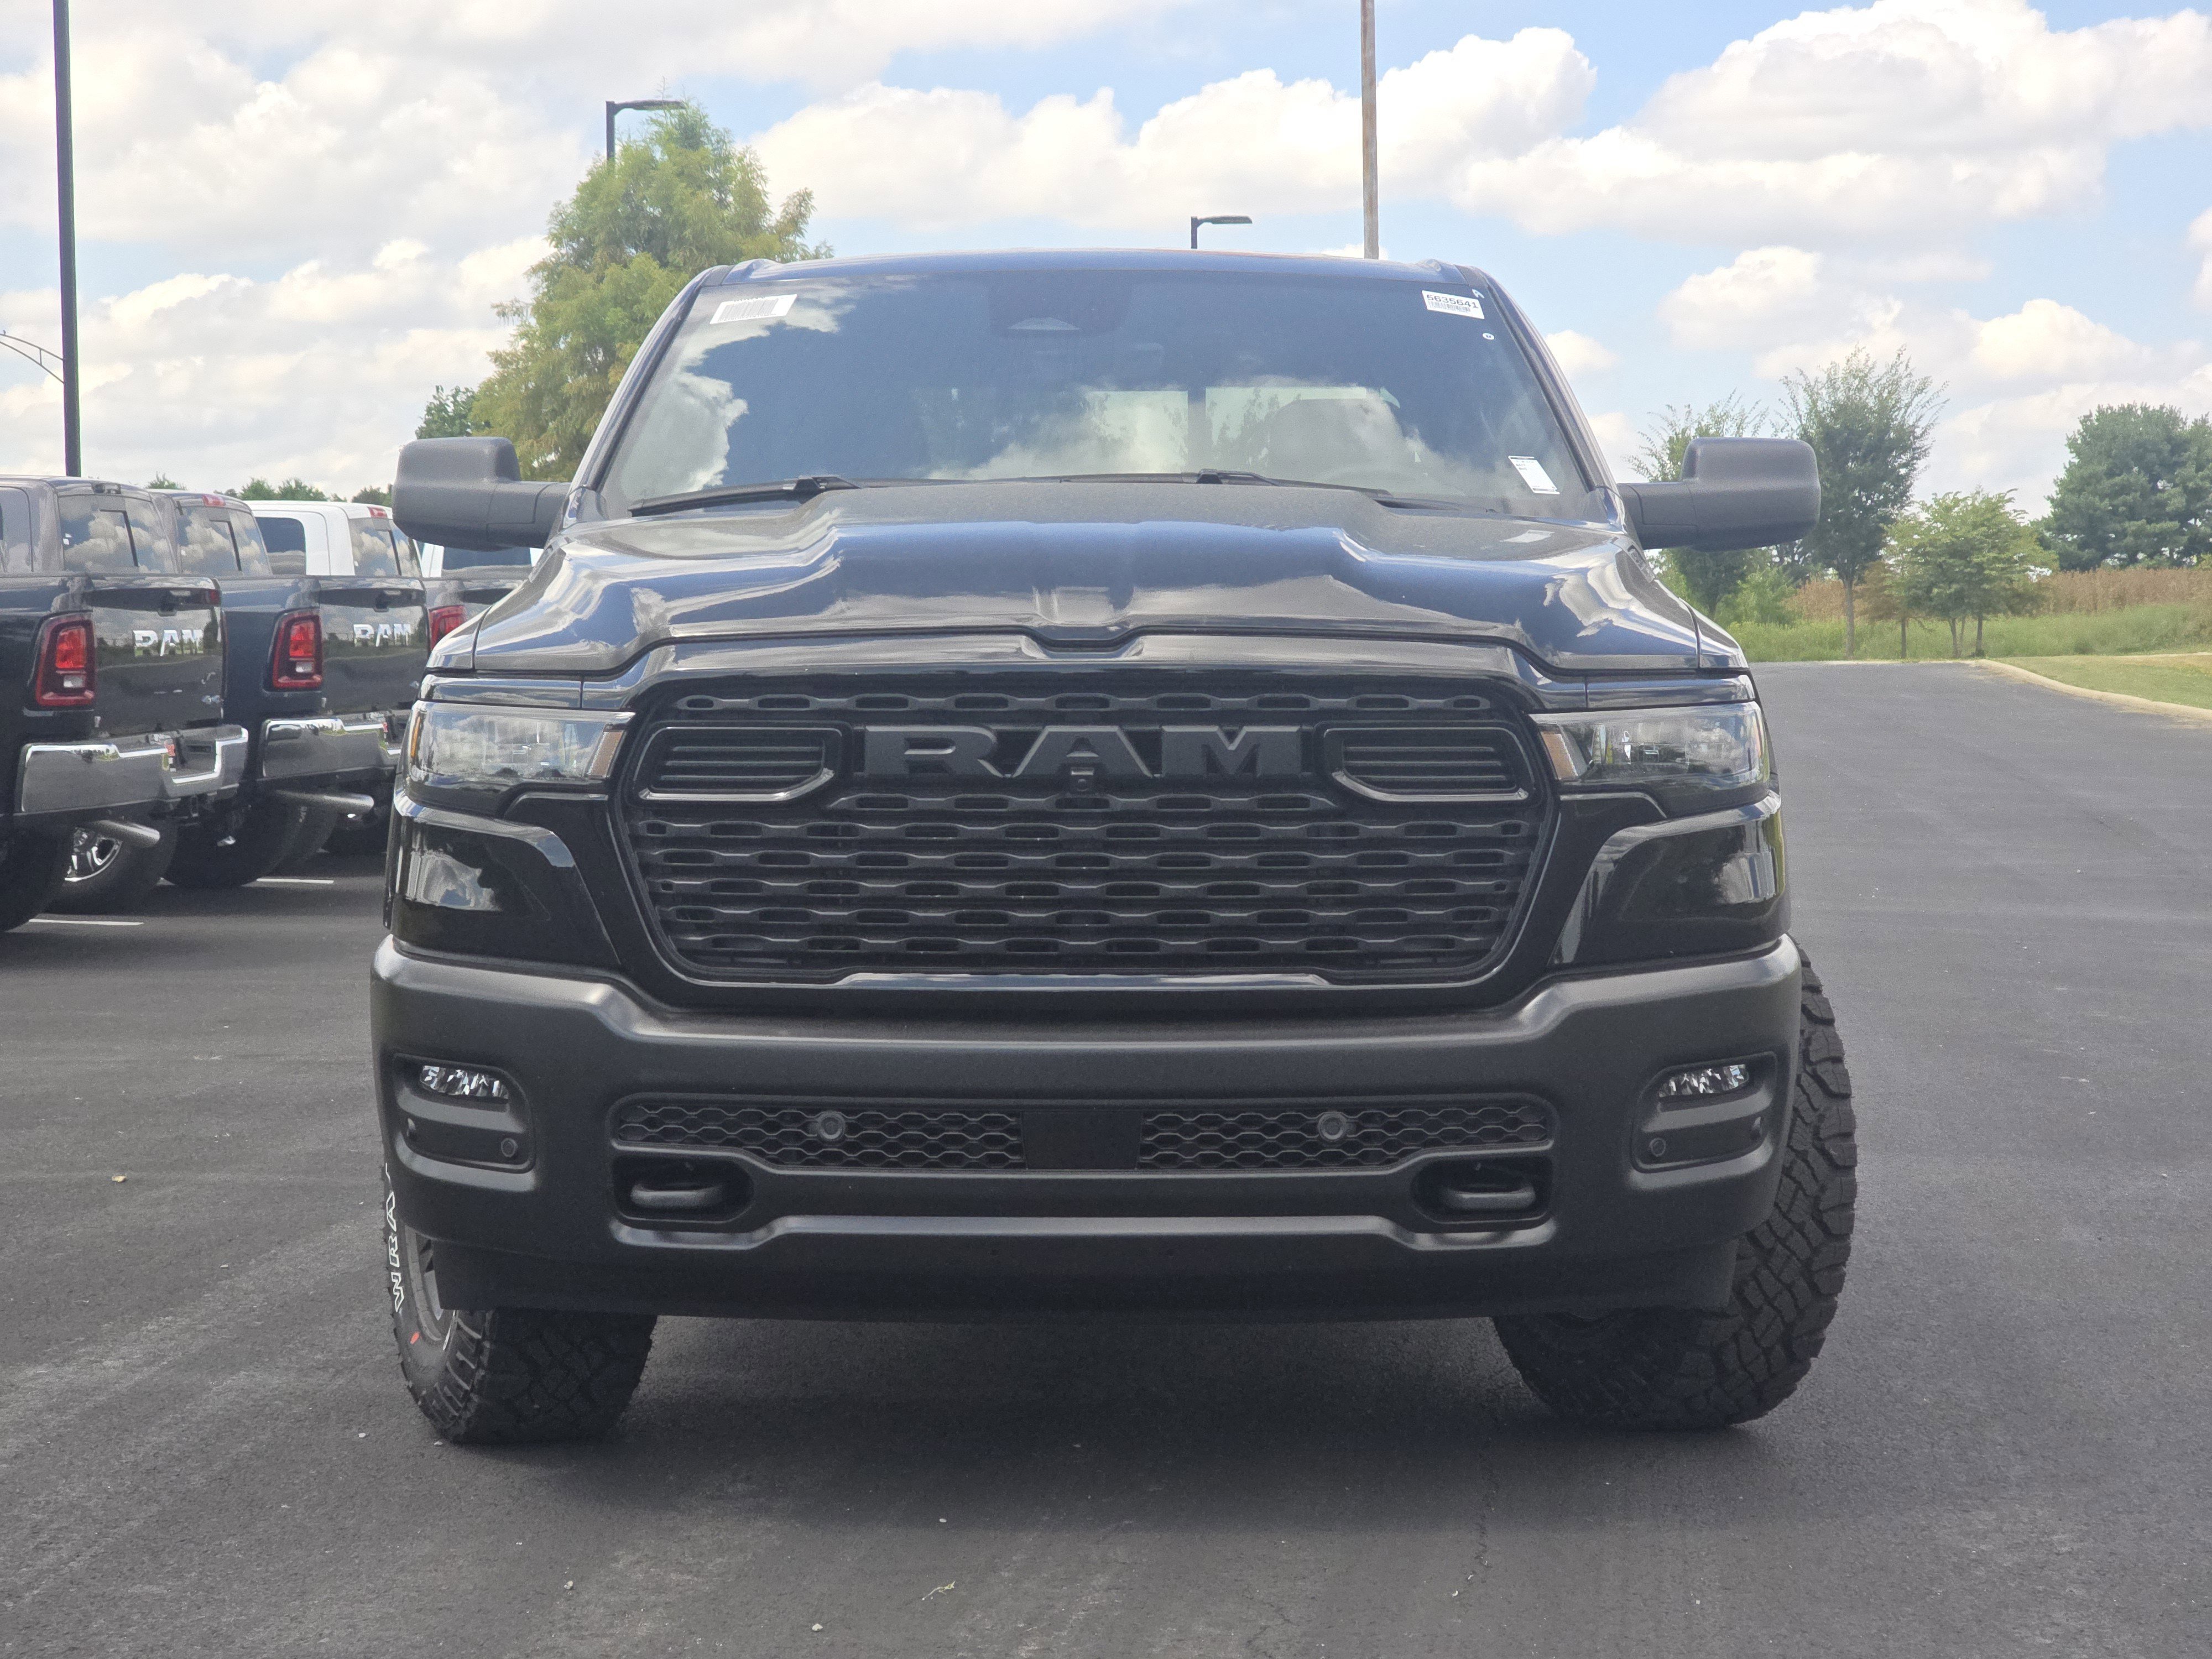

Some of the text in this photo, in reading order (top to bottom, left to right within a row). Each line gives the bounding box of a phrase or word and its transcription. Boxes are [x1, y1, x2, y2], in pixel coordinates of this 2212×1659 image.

[1427, 294, 1479, 309] 5635641
[133, 629, 204, 656] RAM
[353, 624, 411, 647] RAM
[864, 725, 1301, 778] RAM
[385, 1163, 405, 1313] WRA
